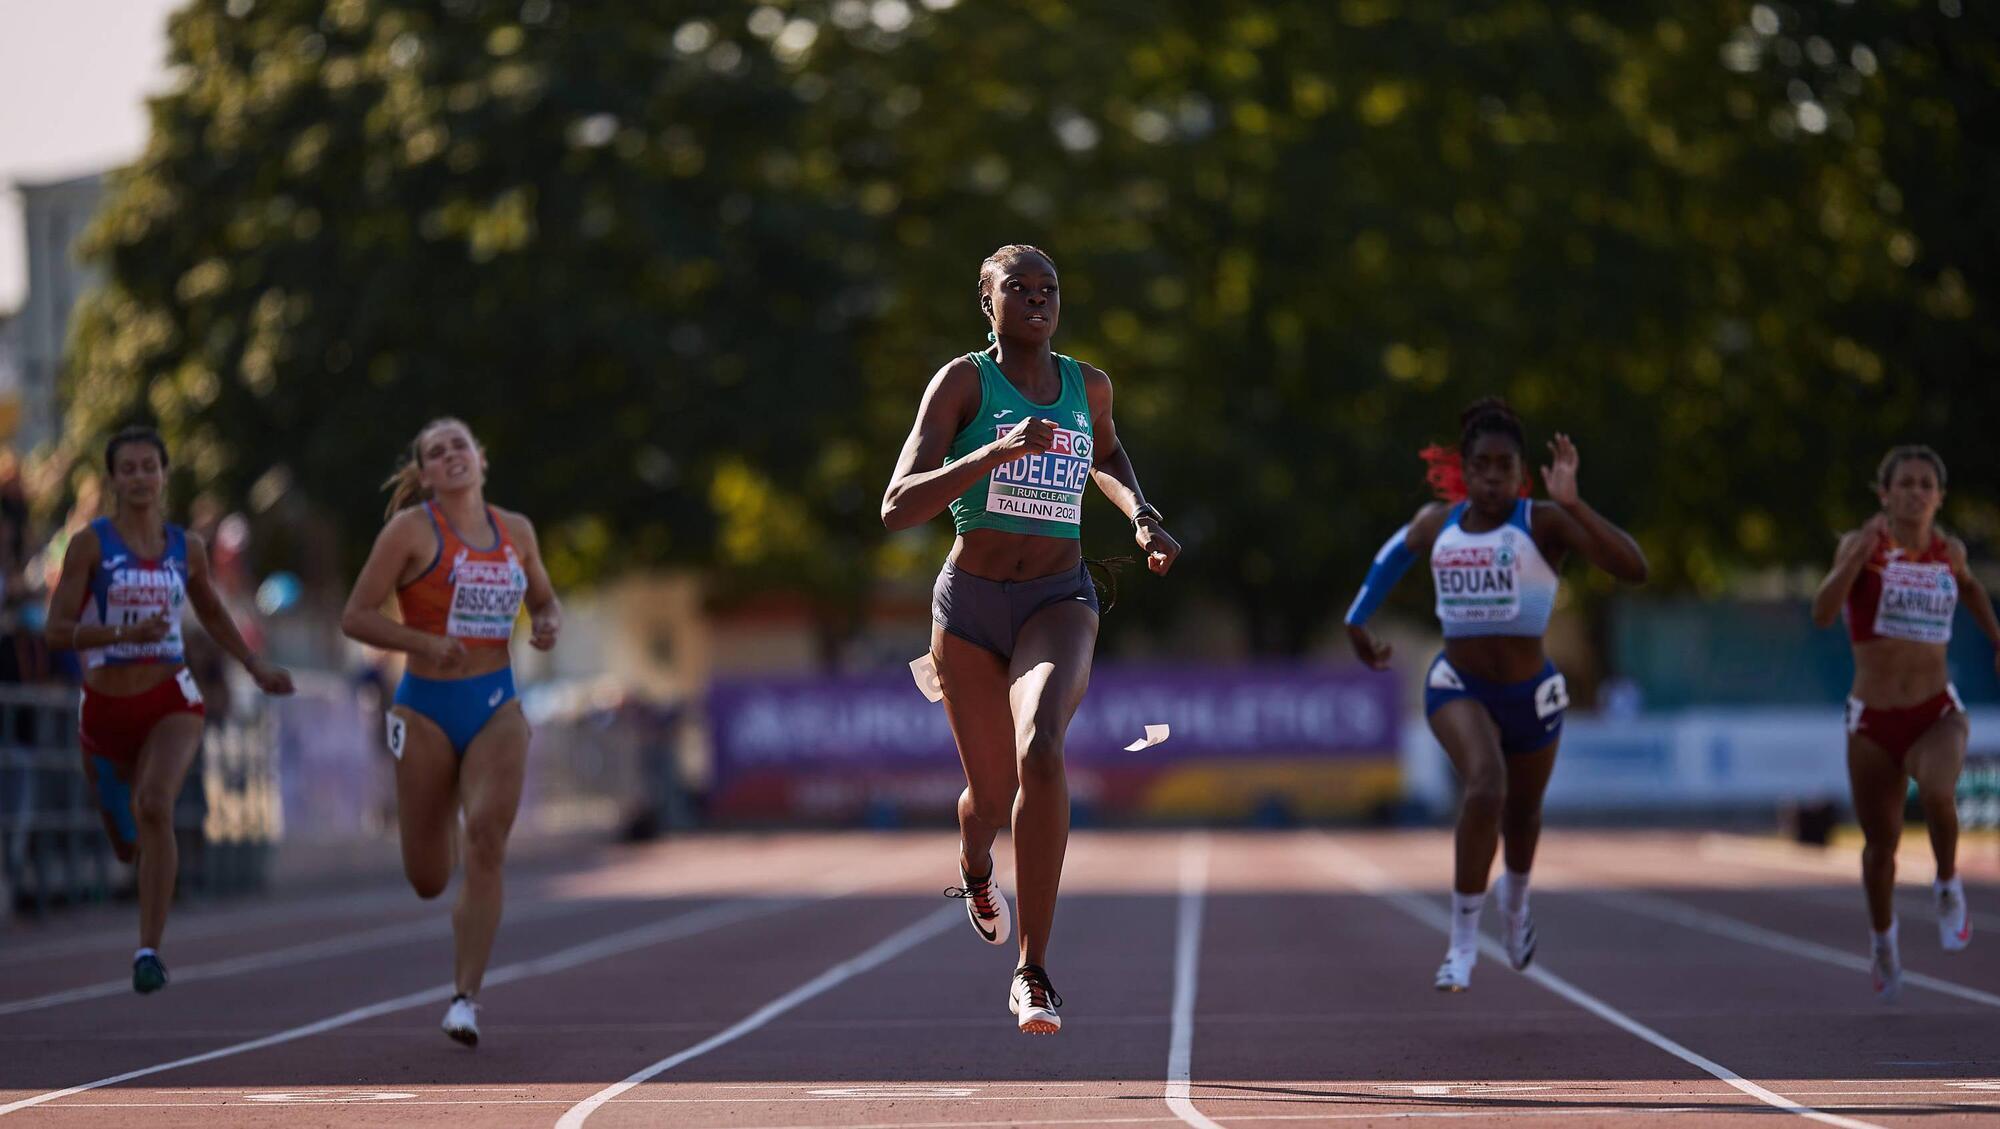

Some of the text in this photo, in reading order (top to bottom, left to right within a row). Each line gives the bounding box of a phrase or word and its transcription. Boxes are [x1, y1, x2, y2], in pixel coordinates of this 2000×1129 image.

[995, 454, 1088, 490] ADELEKE
[1016, 487, 1038, 499] RUN
[998, 497, 1077, 520] TALLINN 2021
[1439, 569, 1514, 595] EDUAN
[1545, 684, 1563, 706] 4
